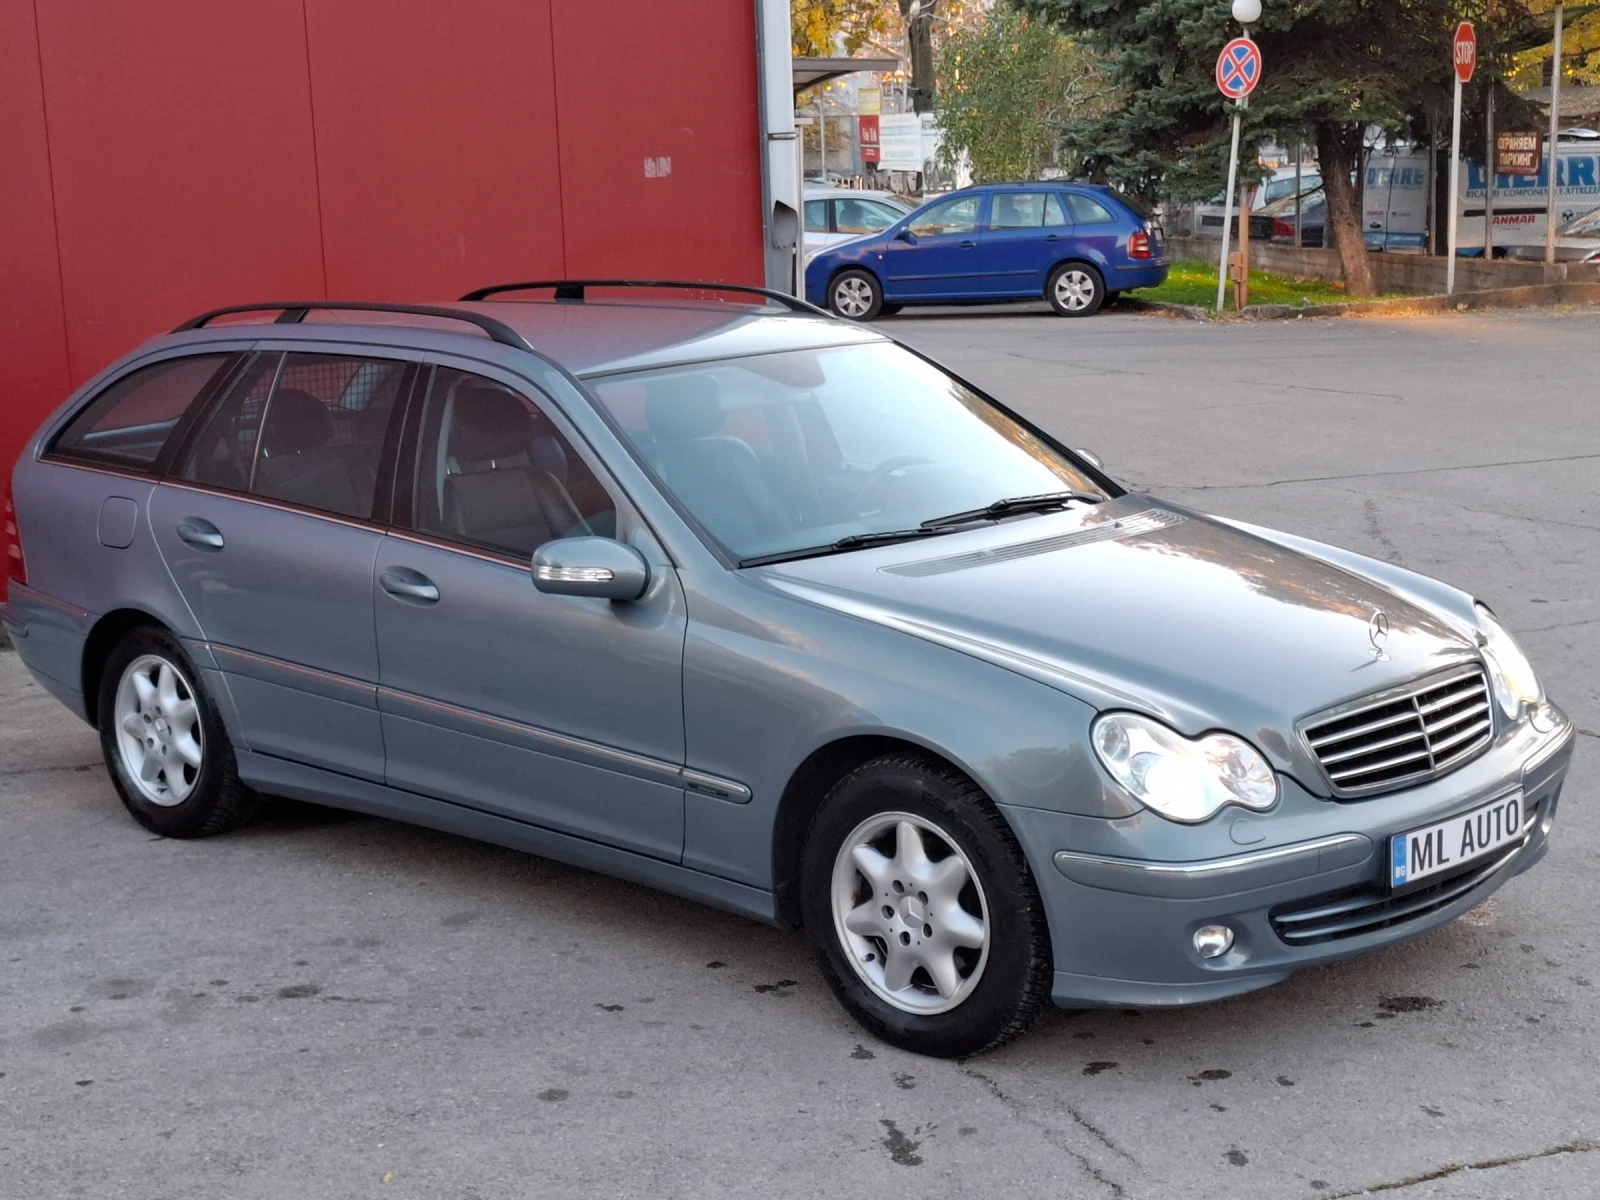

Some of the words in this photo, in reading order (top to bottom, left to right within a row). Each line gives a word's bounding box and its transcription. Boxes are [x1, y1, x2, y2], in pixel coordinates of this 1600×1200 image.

[1456, 41, 1473, 65] STOP
[1499, 152, 1533, 166] ПАРКИНГ
[1491, 215, 1536, 225] ANMAR
[1411, 829, 1449, 874] ML
[1460, 799, 1519, 857] AUTO
[1395, 866, 1406, 879] BG
